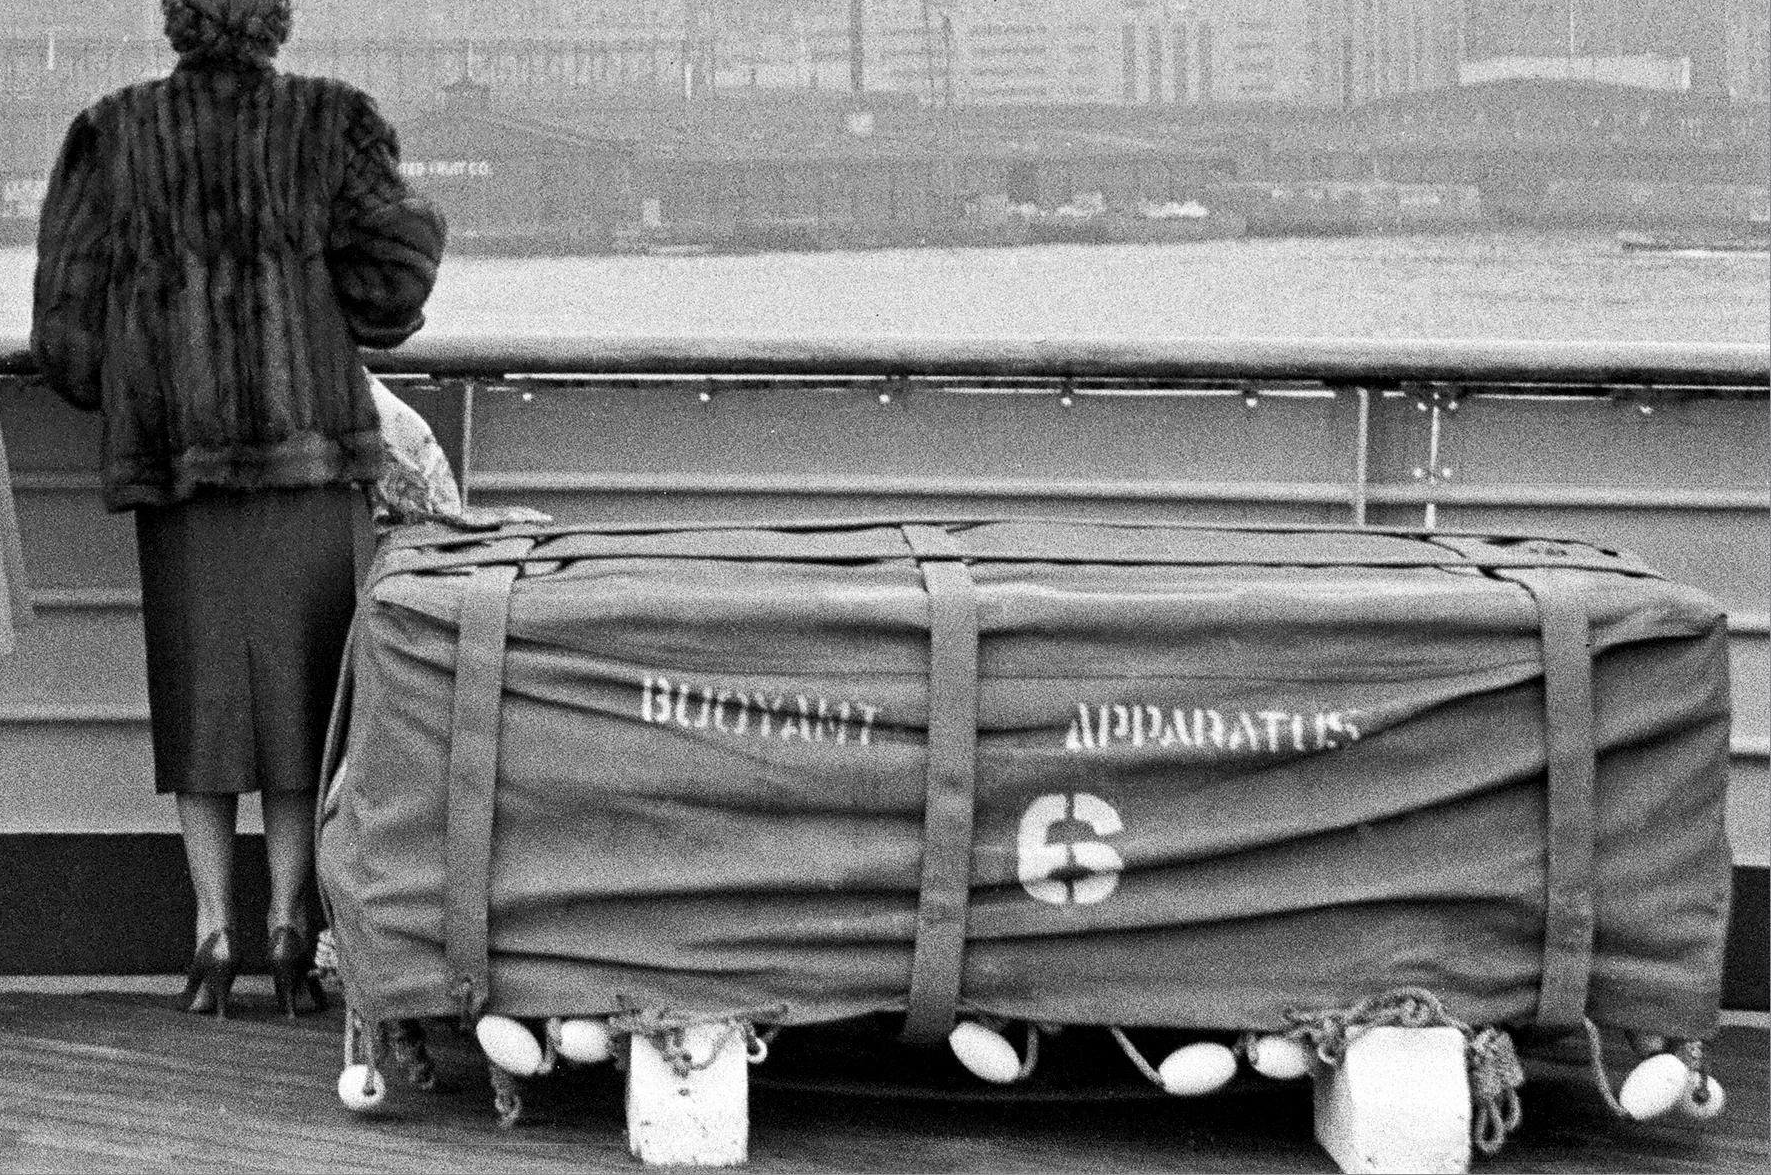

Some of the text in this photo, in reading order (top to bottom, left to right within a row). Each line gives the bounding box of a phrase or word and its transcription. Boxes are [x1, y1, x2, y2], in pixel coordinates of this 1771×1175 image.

[642, 676, 1360, 753] BUOYANT APPARATUS
[1017, 792, 1125, 905] 6
